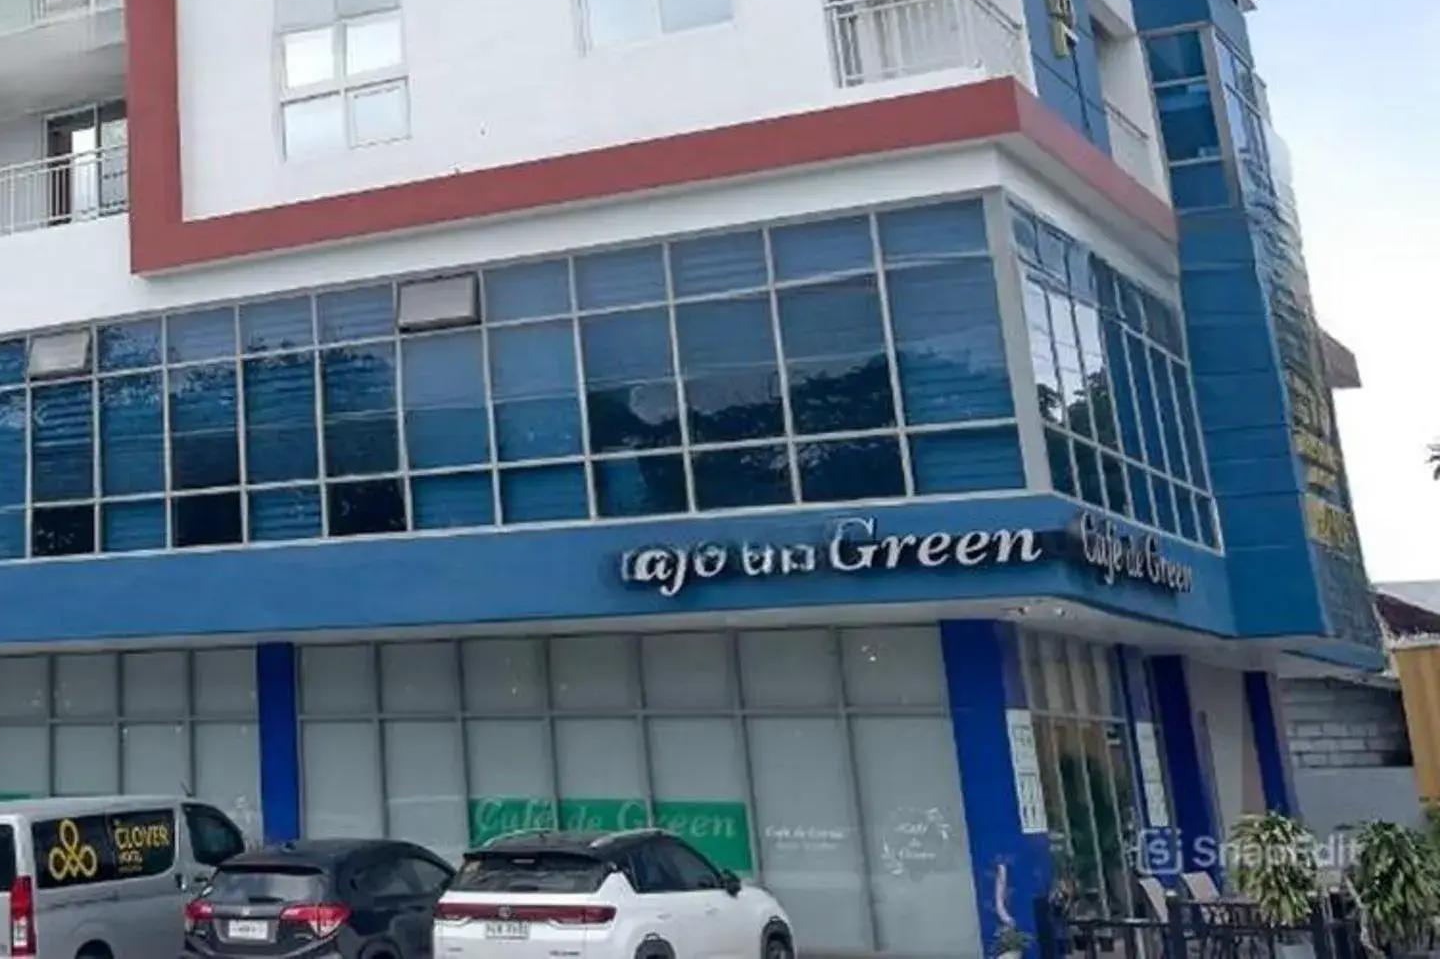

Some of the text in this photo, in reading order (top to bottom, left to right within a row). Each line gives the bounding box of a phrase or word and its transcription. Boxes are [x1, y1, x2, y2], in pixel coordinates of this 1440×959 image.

[829, 517, 1042, 572] Green
[1145, 532, 1194, 593] Green
[115, 825, 170, 849] CLOVER
[567, 804, 604, 831] de
[616, 800, 738, 839] Green
